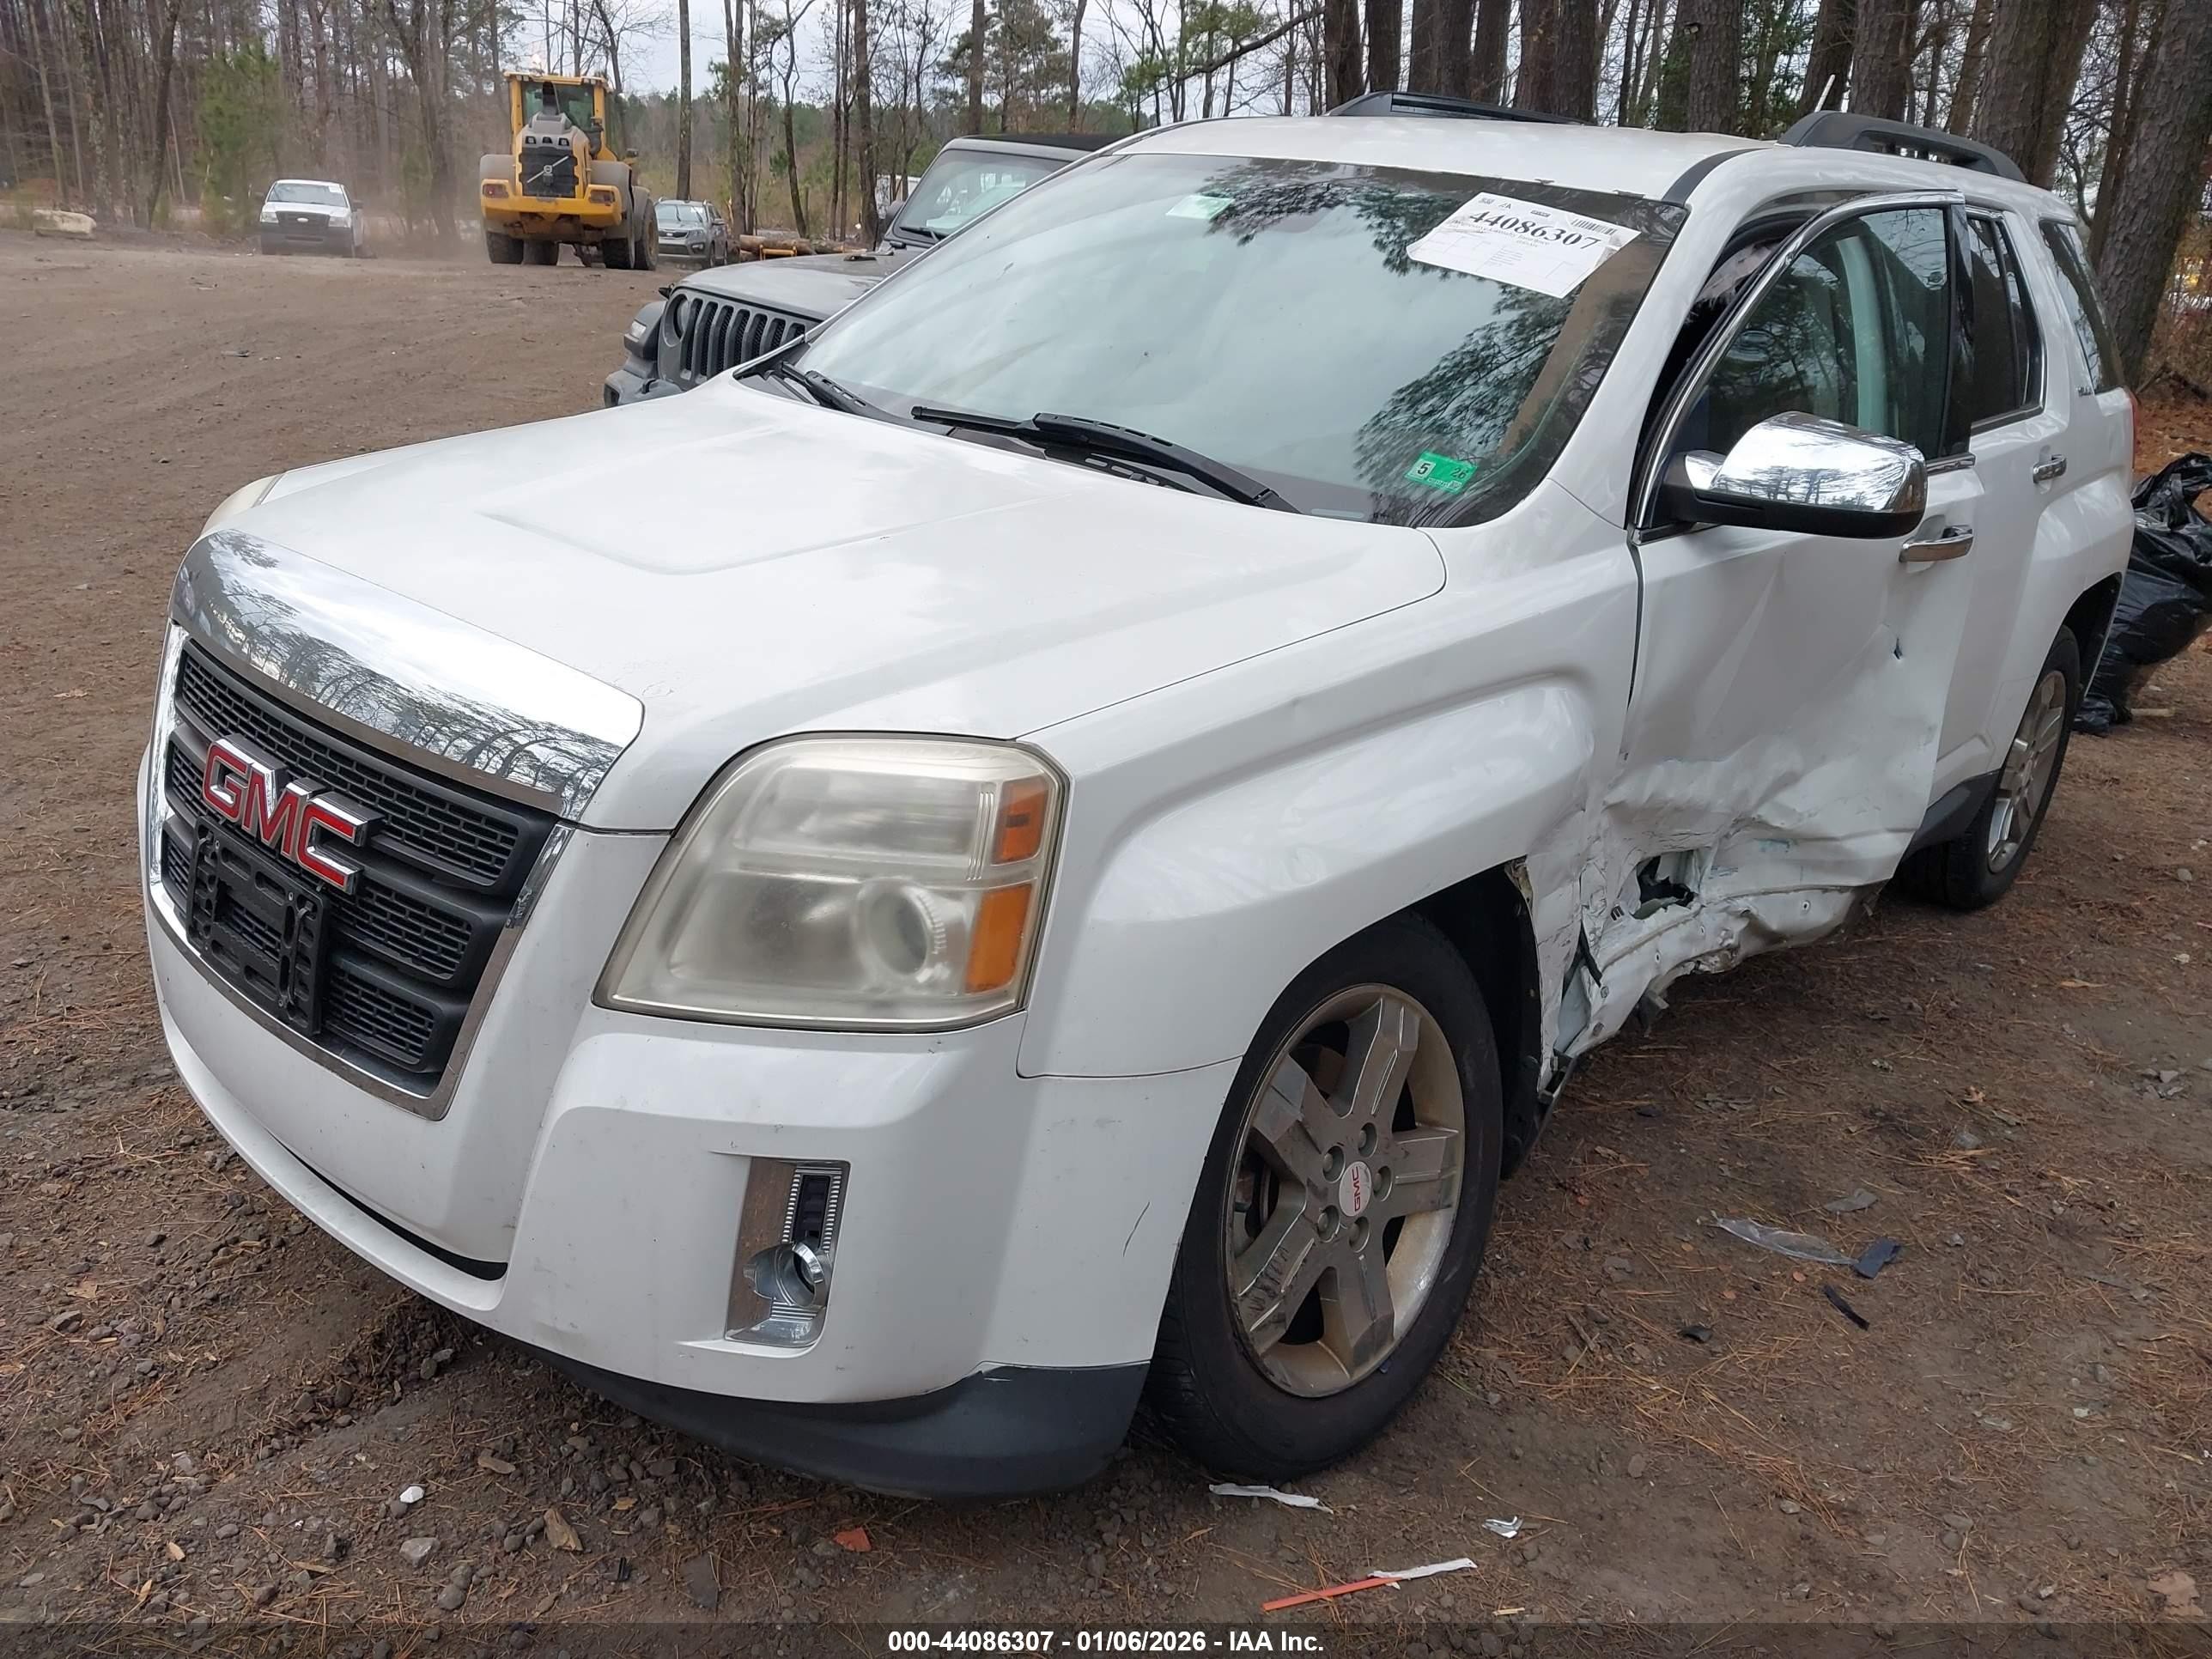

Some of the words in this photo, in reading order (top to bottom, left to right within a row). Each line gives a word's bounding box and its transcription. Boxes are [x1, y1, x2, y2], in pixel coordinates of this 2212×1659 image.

[1469, 210, 1601, 249] 44086307
[1417, 463, 1431, 475] 5
[203, 735, 373, 895] GMC
[1352, 1166, 1361, 1212] GMC
